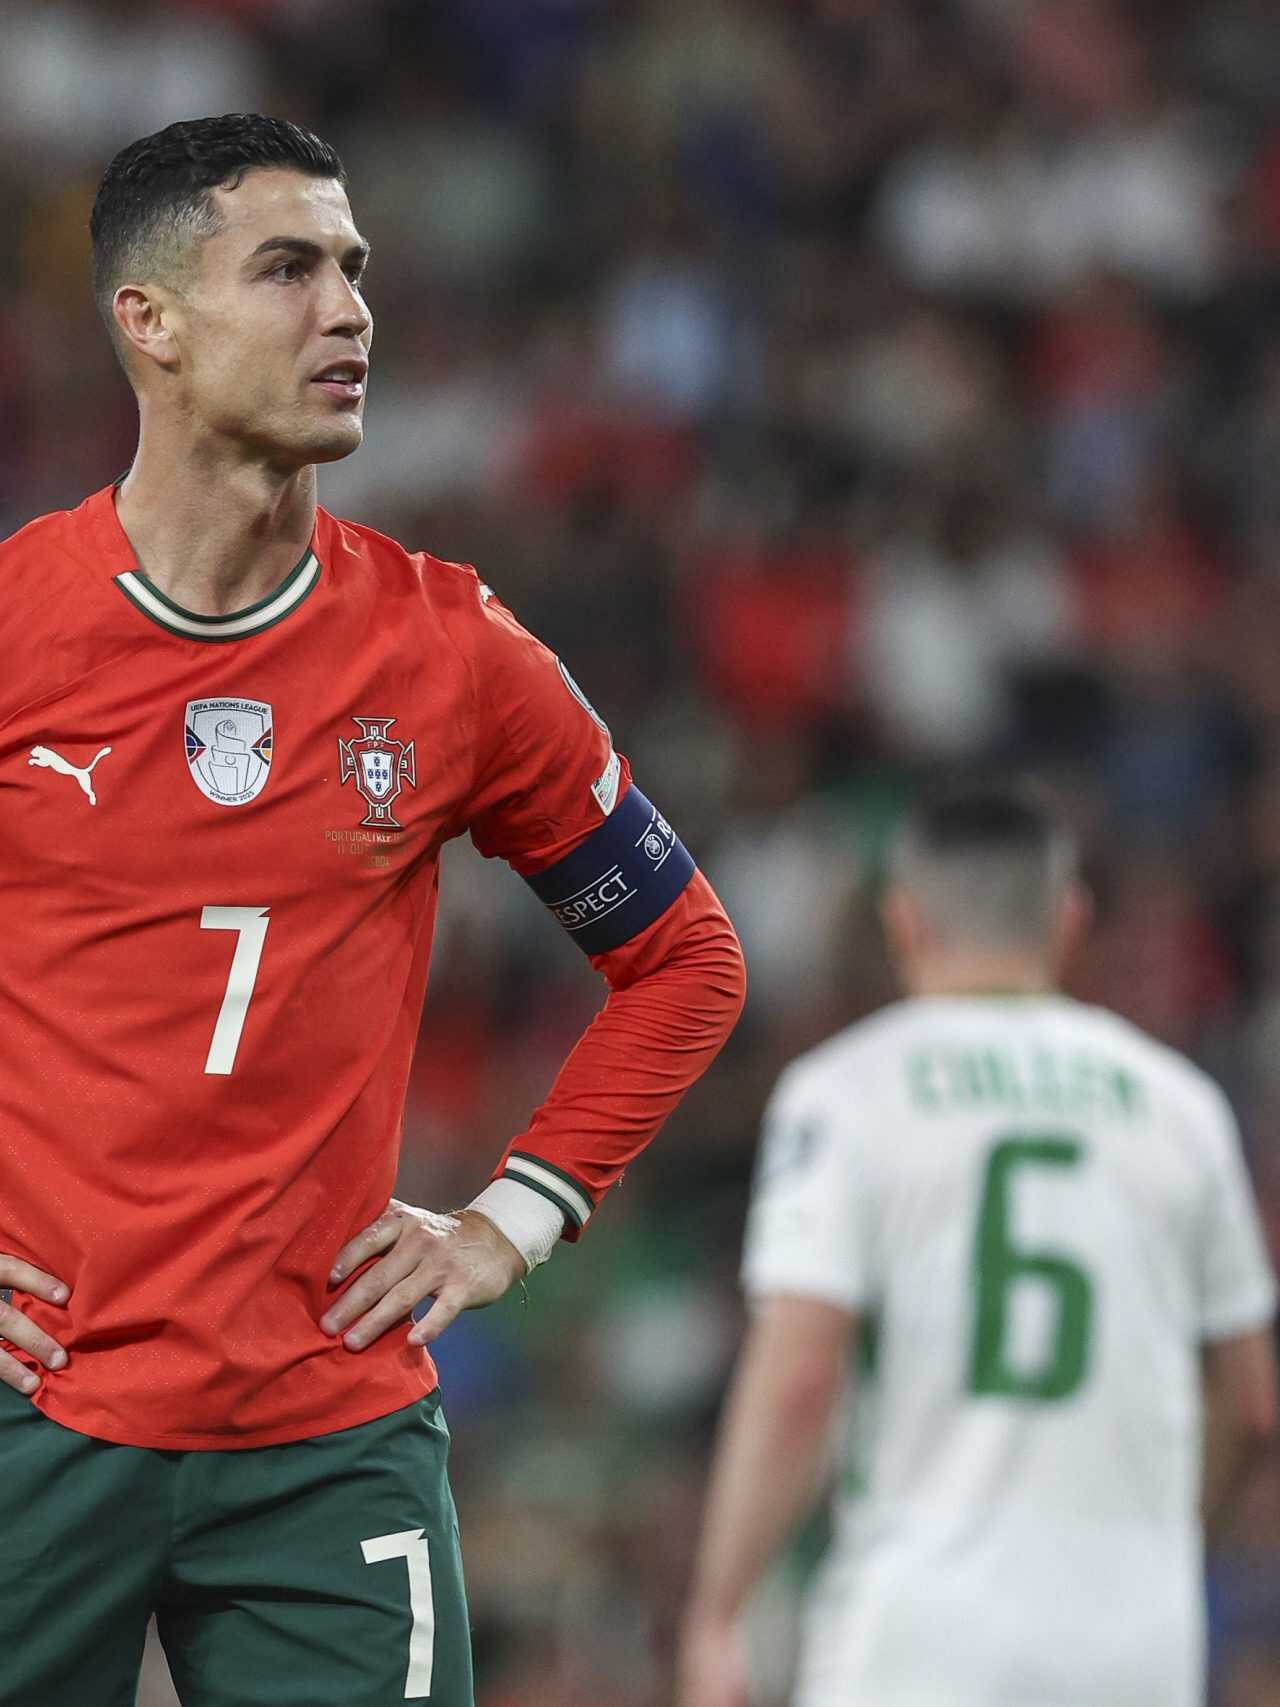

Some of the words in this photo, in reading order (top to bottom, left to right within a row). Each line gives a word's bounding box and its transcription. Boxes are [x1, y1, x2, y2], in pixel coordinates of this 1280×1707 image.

[191, 703, 208, 711] UEFA
[241, 703, 268, 714] LEAGUE
[210, 789, 238, 801] WINNER
[325, 831, 372, 842] PORTUGAL
[553, 871, 628, 924] ESPECT
[200, 906, 271, 1075] 7
[968, 1134, 1094, 1404] 6
[360, 1528, 435, 1698] 7
